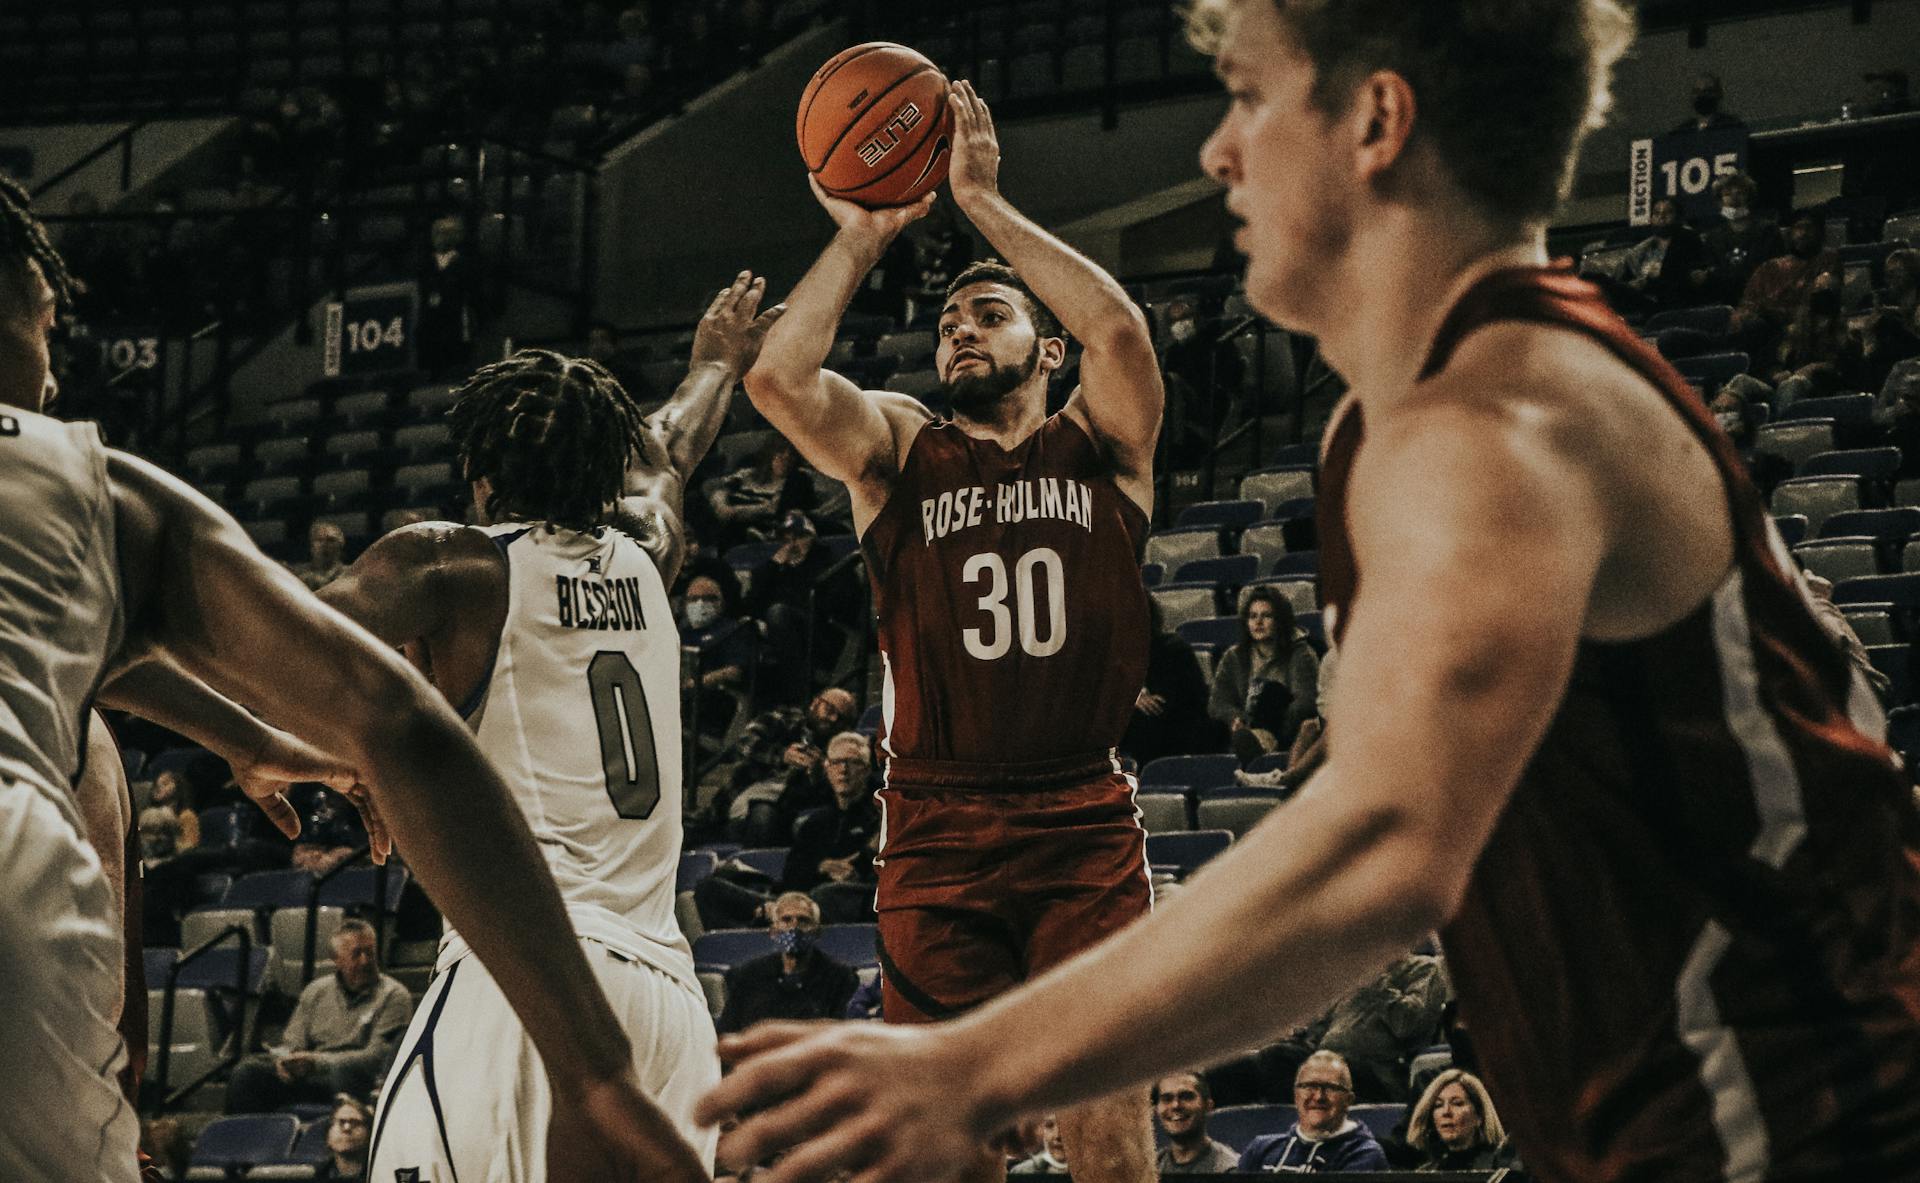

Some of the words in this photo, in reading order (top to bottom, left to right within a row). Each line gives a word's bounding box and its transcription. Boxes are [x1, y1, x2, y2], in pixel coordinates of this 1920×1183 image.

[857, 102, 924, 167] ELITE
[1635, 148, 1648, 217] SECTION
[1660, 152, 1738, 197] 105
[346, 316, 405, 352] 104
[556, 574, 647, 631] BLEDSON
[962, 547, 1067, 661] 30
[586, 650, 661, 819] 0
